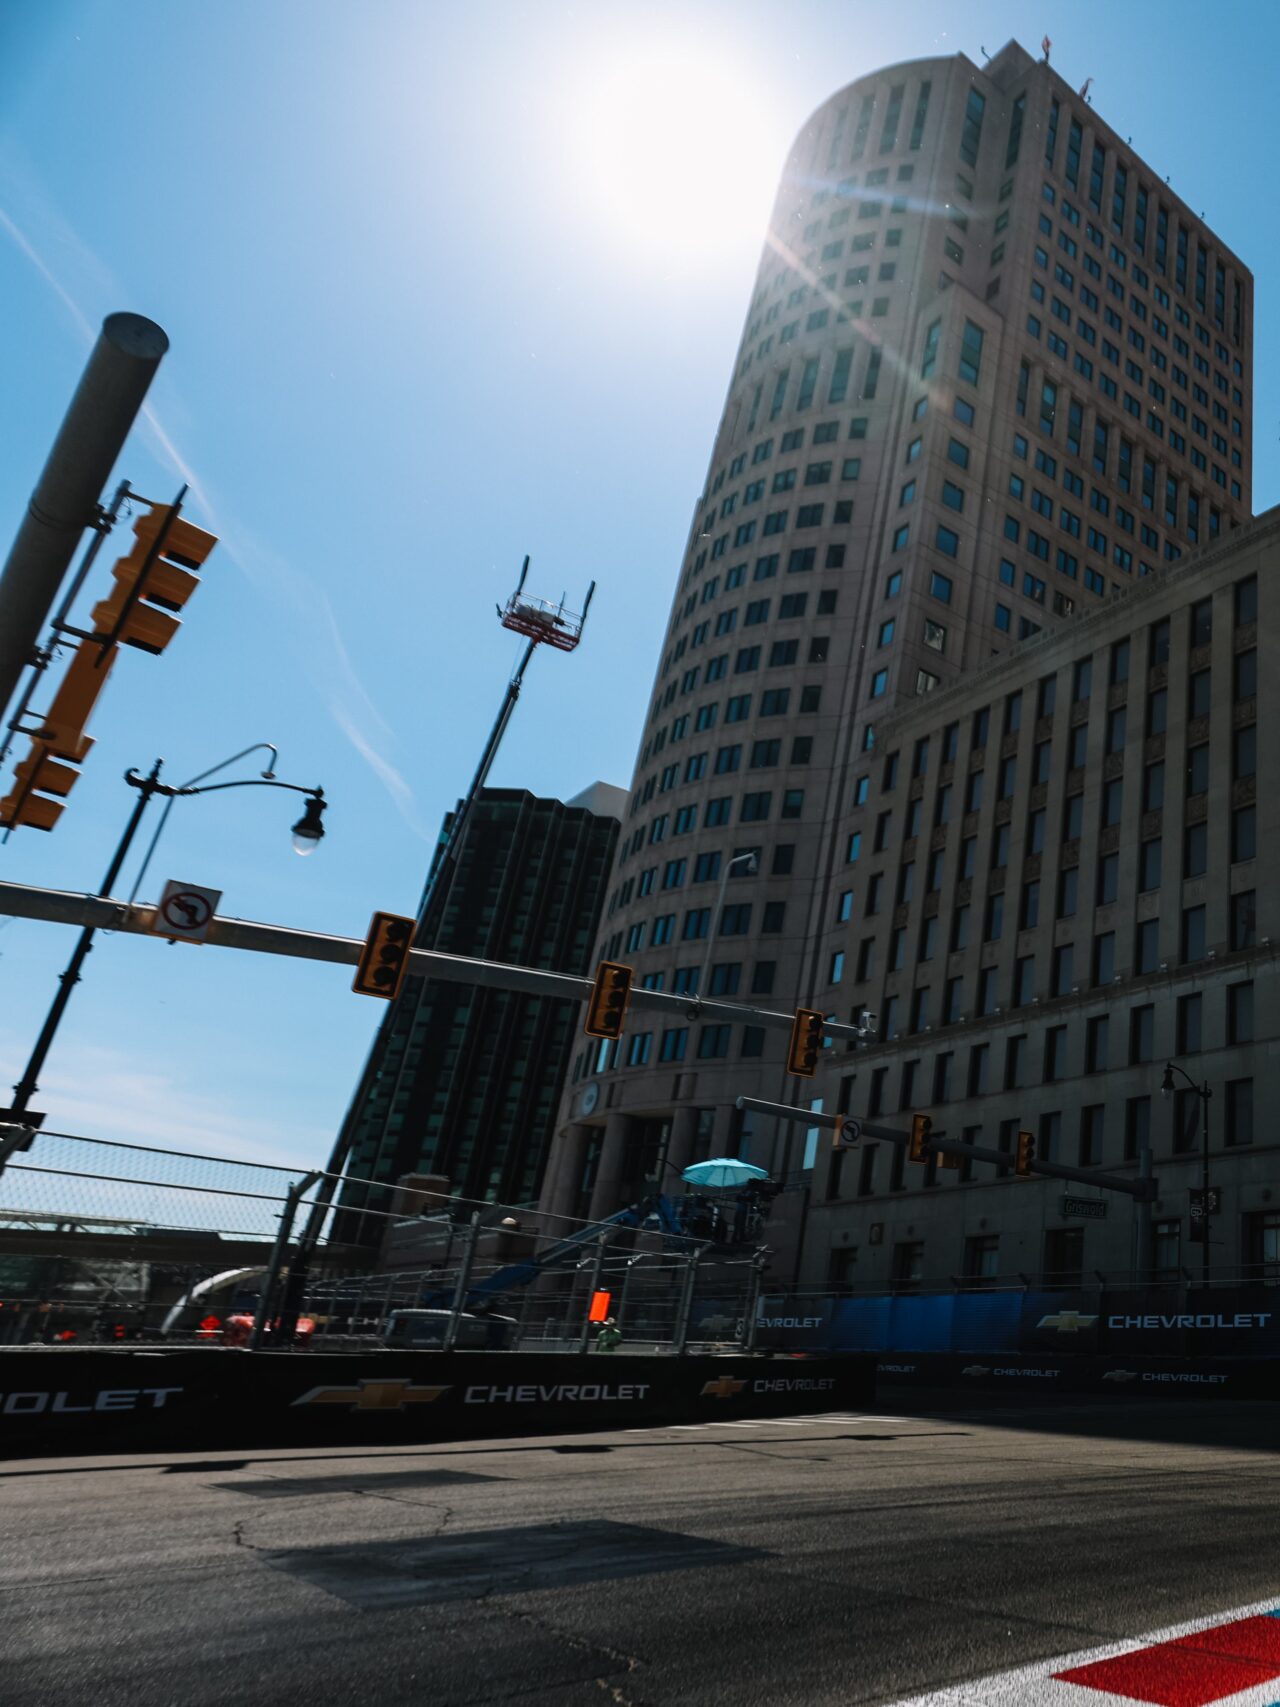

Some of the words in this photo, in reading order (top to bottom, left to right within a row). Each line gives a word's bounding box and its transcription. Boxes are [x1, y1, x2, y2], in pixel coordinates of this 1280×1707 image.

[1065, 1199, 1105, 1217] Griswold
[756, 1316, 824, 1328] EVROLET
[1107, 1312, 1272, 1329] CHEVROLET
[876, 1363, 917, 1373] VROLET
[993, 1367, 1061, 1377] CHEVROLET
[753, 1377, 836, 1393] CHEVROLET
[1142, 1372, 1229, 1384] CHEVROLET
[0, 1387, 184, 1414] OLET
[463, 1384, 650, 1404] CHEVROLET
